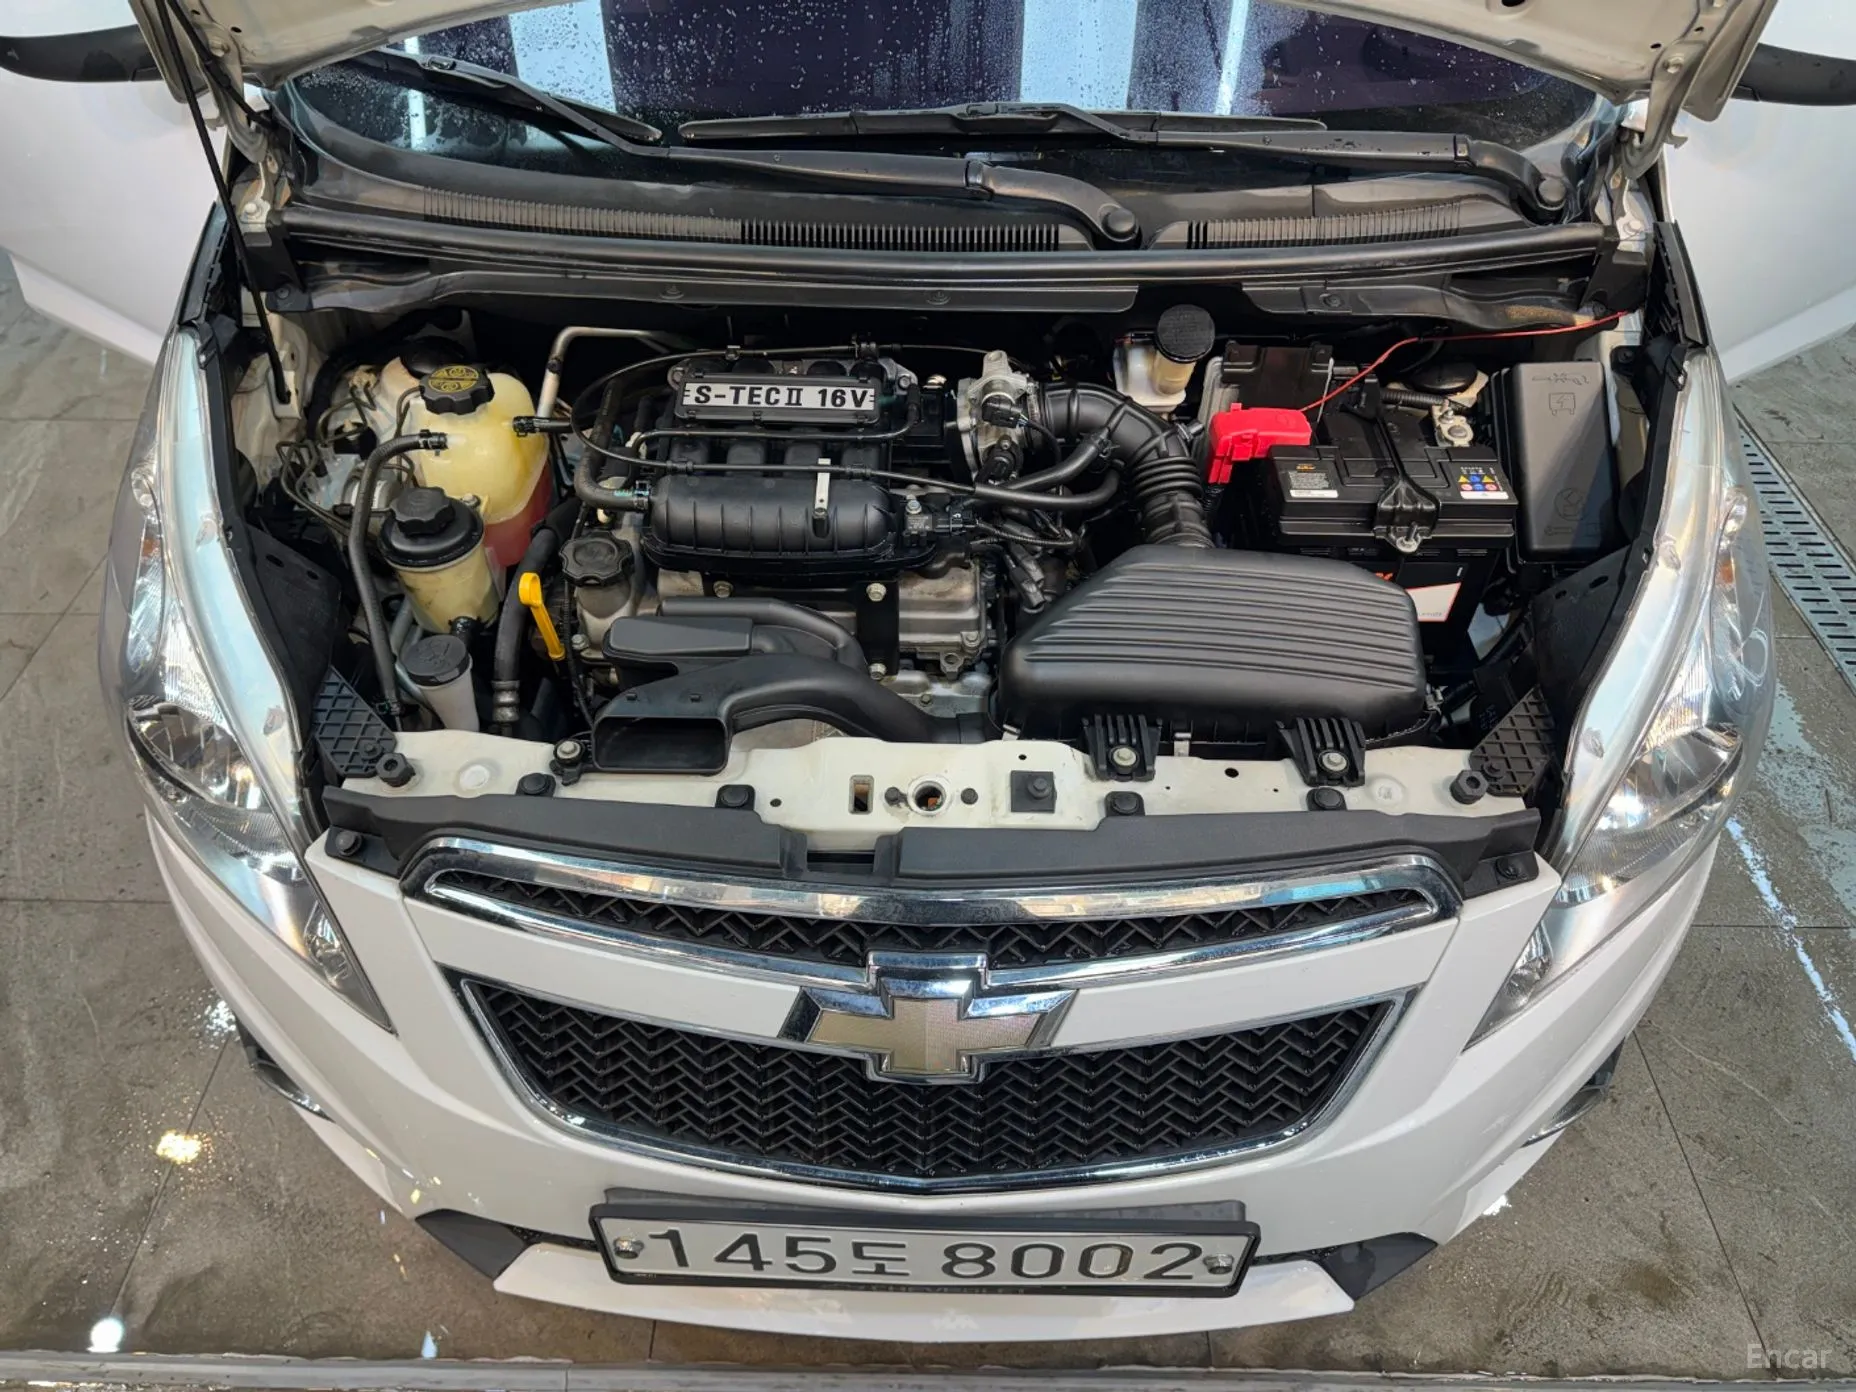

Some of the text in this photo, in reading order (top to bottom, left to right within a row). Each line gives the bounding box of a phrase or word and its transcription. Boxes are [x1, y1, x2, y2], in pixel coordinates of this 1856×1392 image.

[818, 388, 869, 408] 16V
[648, 1229, 1203, 1280] 145도 8002
